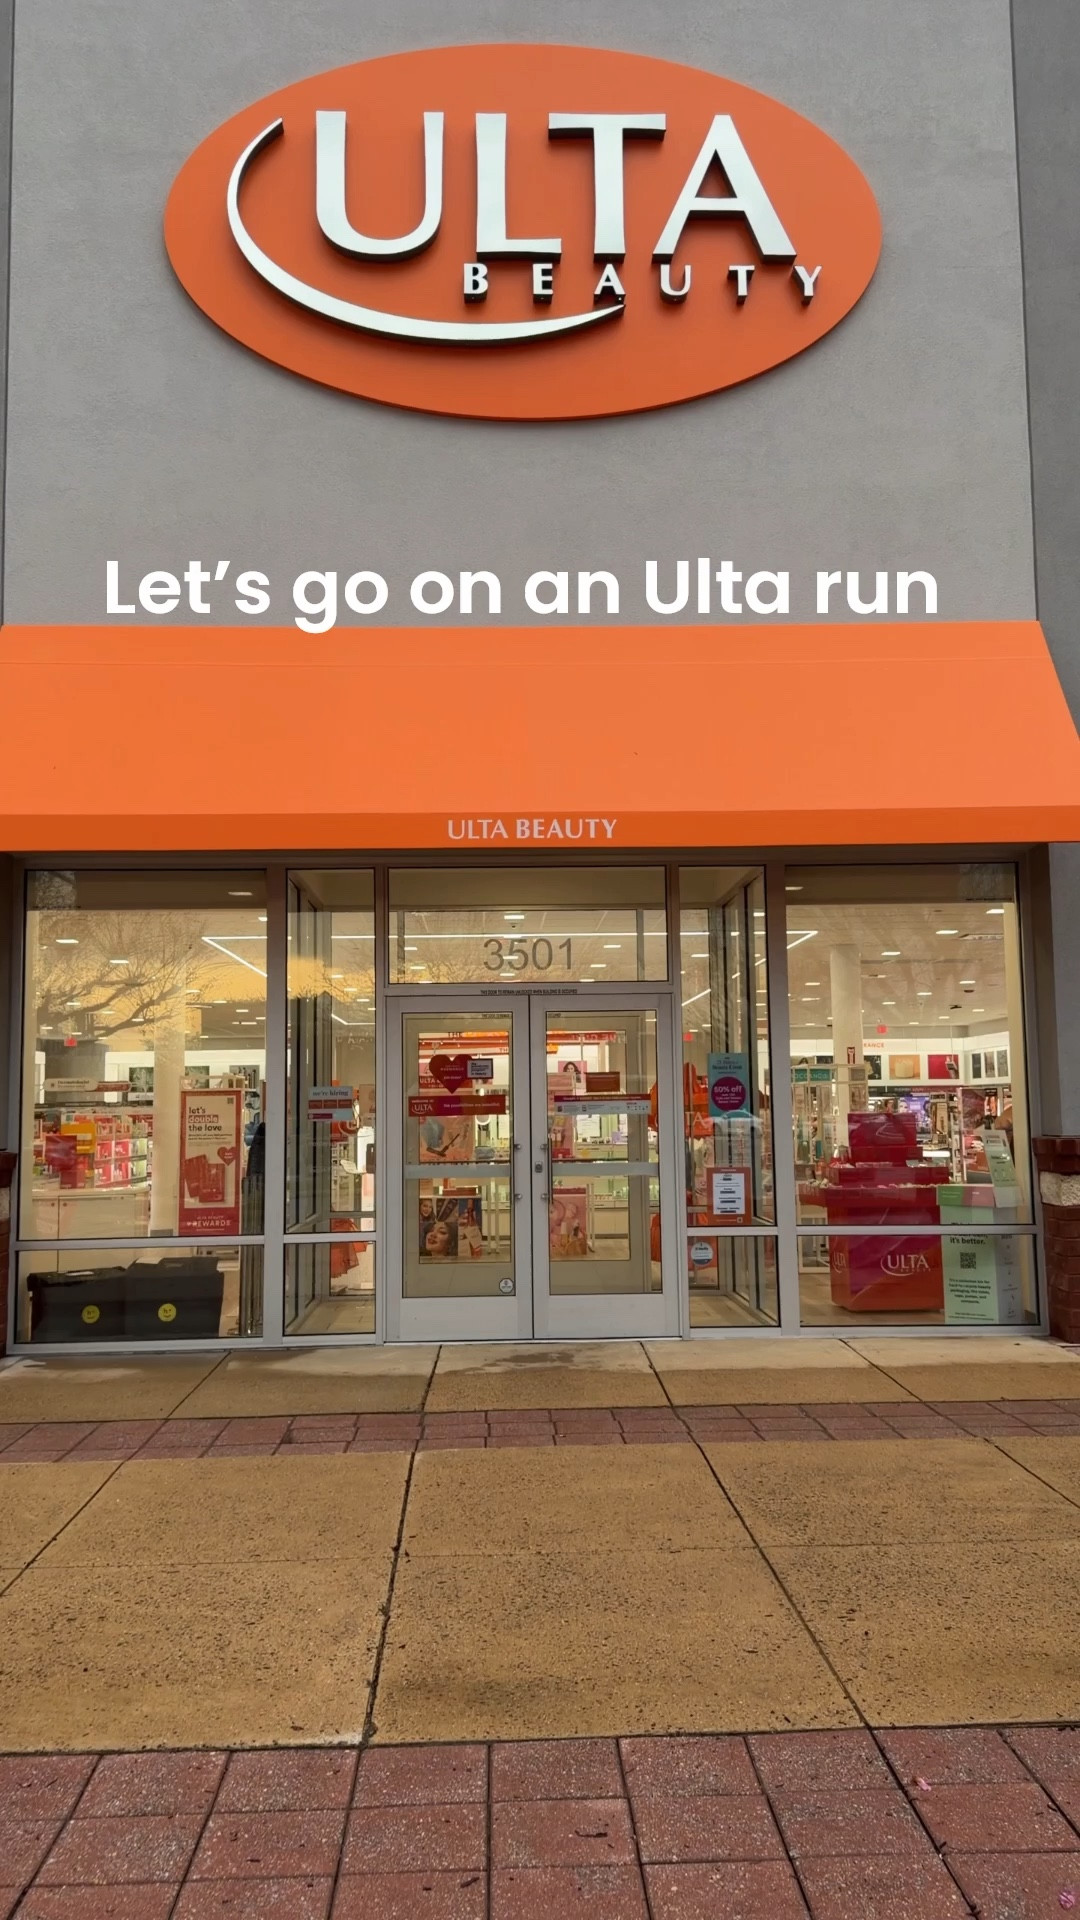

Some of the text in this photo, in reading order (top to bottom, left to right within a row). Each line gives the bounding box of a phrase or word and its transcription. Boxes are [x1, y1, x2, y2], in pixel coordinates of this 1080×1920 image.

[316, 110, 797, 262] ULTA
[463, 263, 823, 303] BEAUTY
[447, 818, 617, 840] ULTA BEAUTY
[483, 938, 572, 971] 3501
[329, 1089, 349, 1097] hiring
[188, 1115, 218, 1123] double
[188, 1124, 222, 1132] the love
[961, 1237, 986, 1245] better.
[887, 1254, 931, 1269] ULTA
